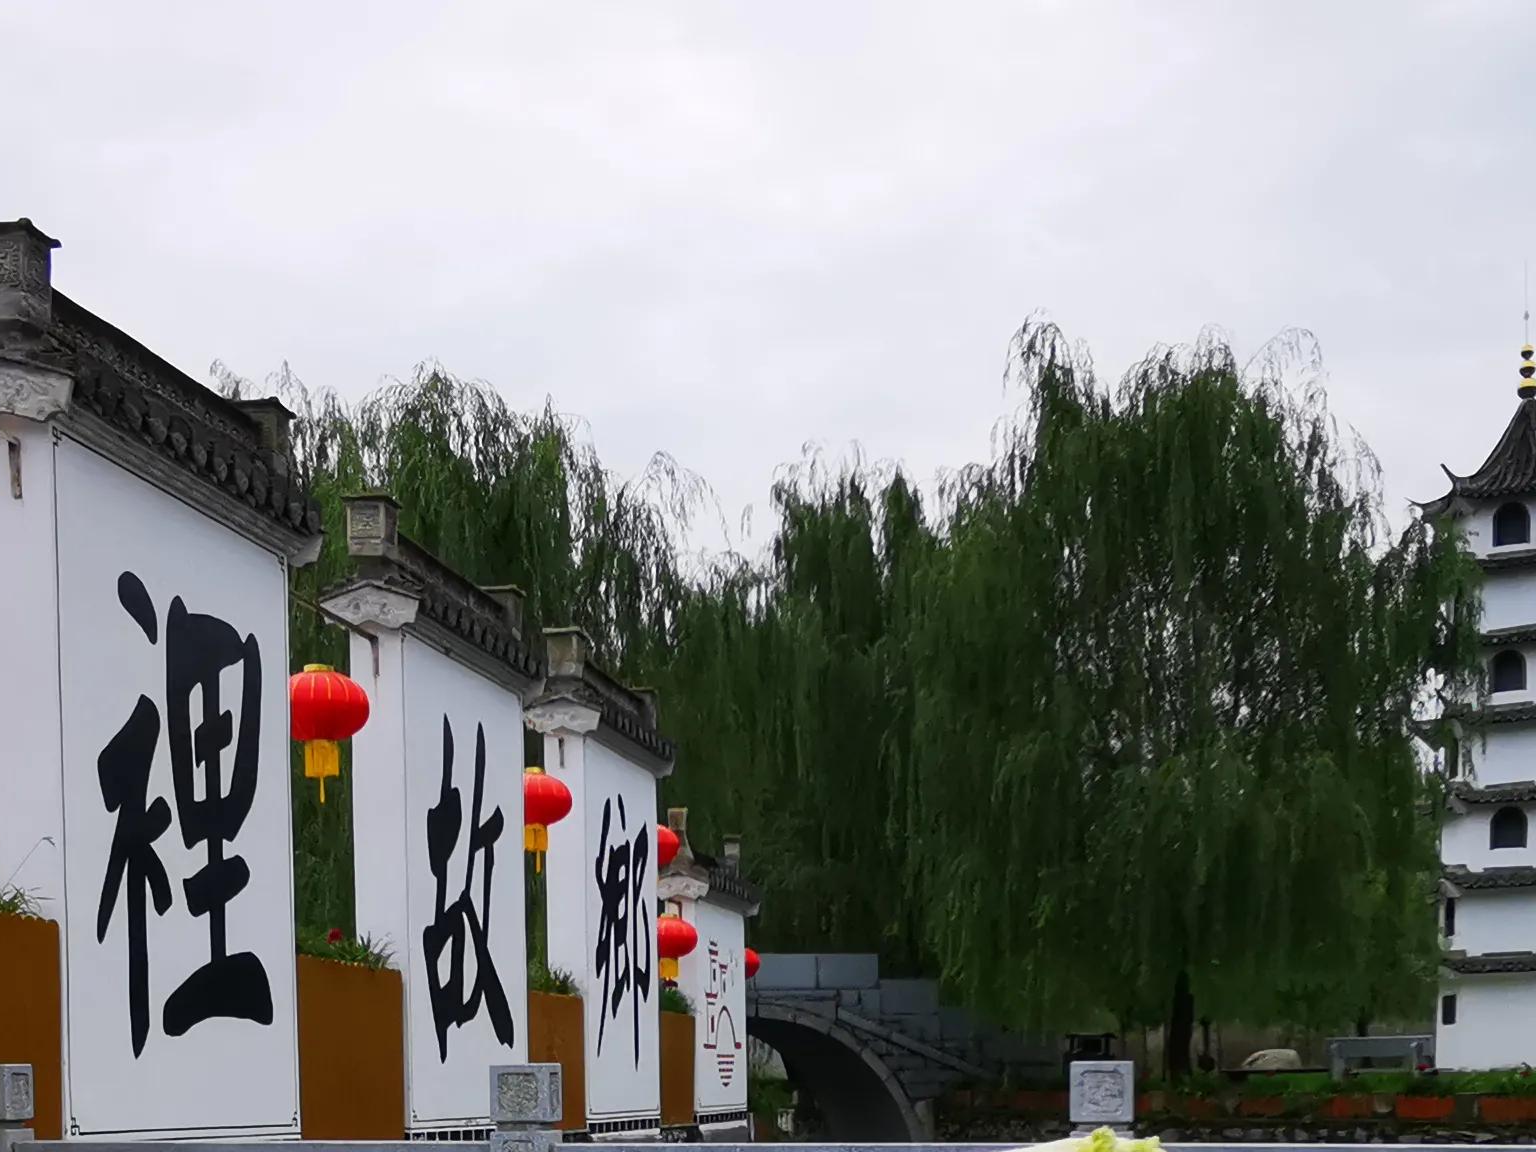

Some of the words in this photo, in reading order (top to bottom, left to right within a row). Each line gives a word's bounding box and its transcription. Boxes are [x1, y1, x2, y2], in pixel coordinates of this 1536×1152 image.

[97, 570, 274, 1060] 裡
[422, 713, 515, 1064] 故
[595, 793, 651, 1072] 鄉
